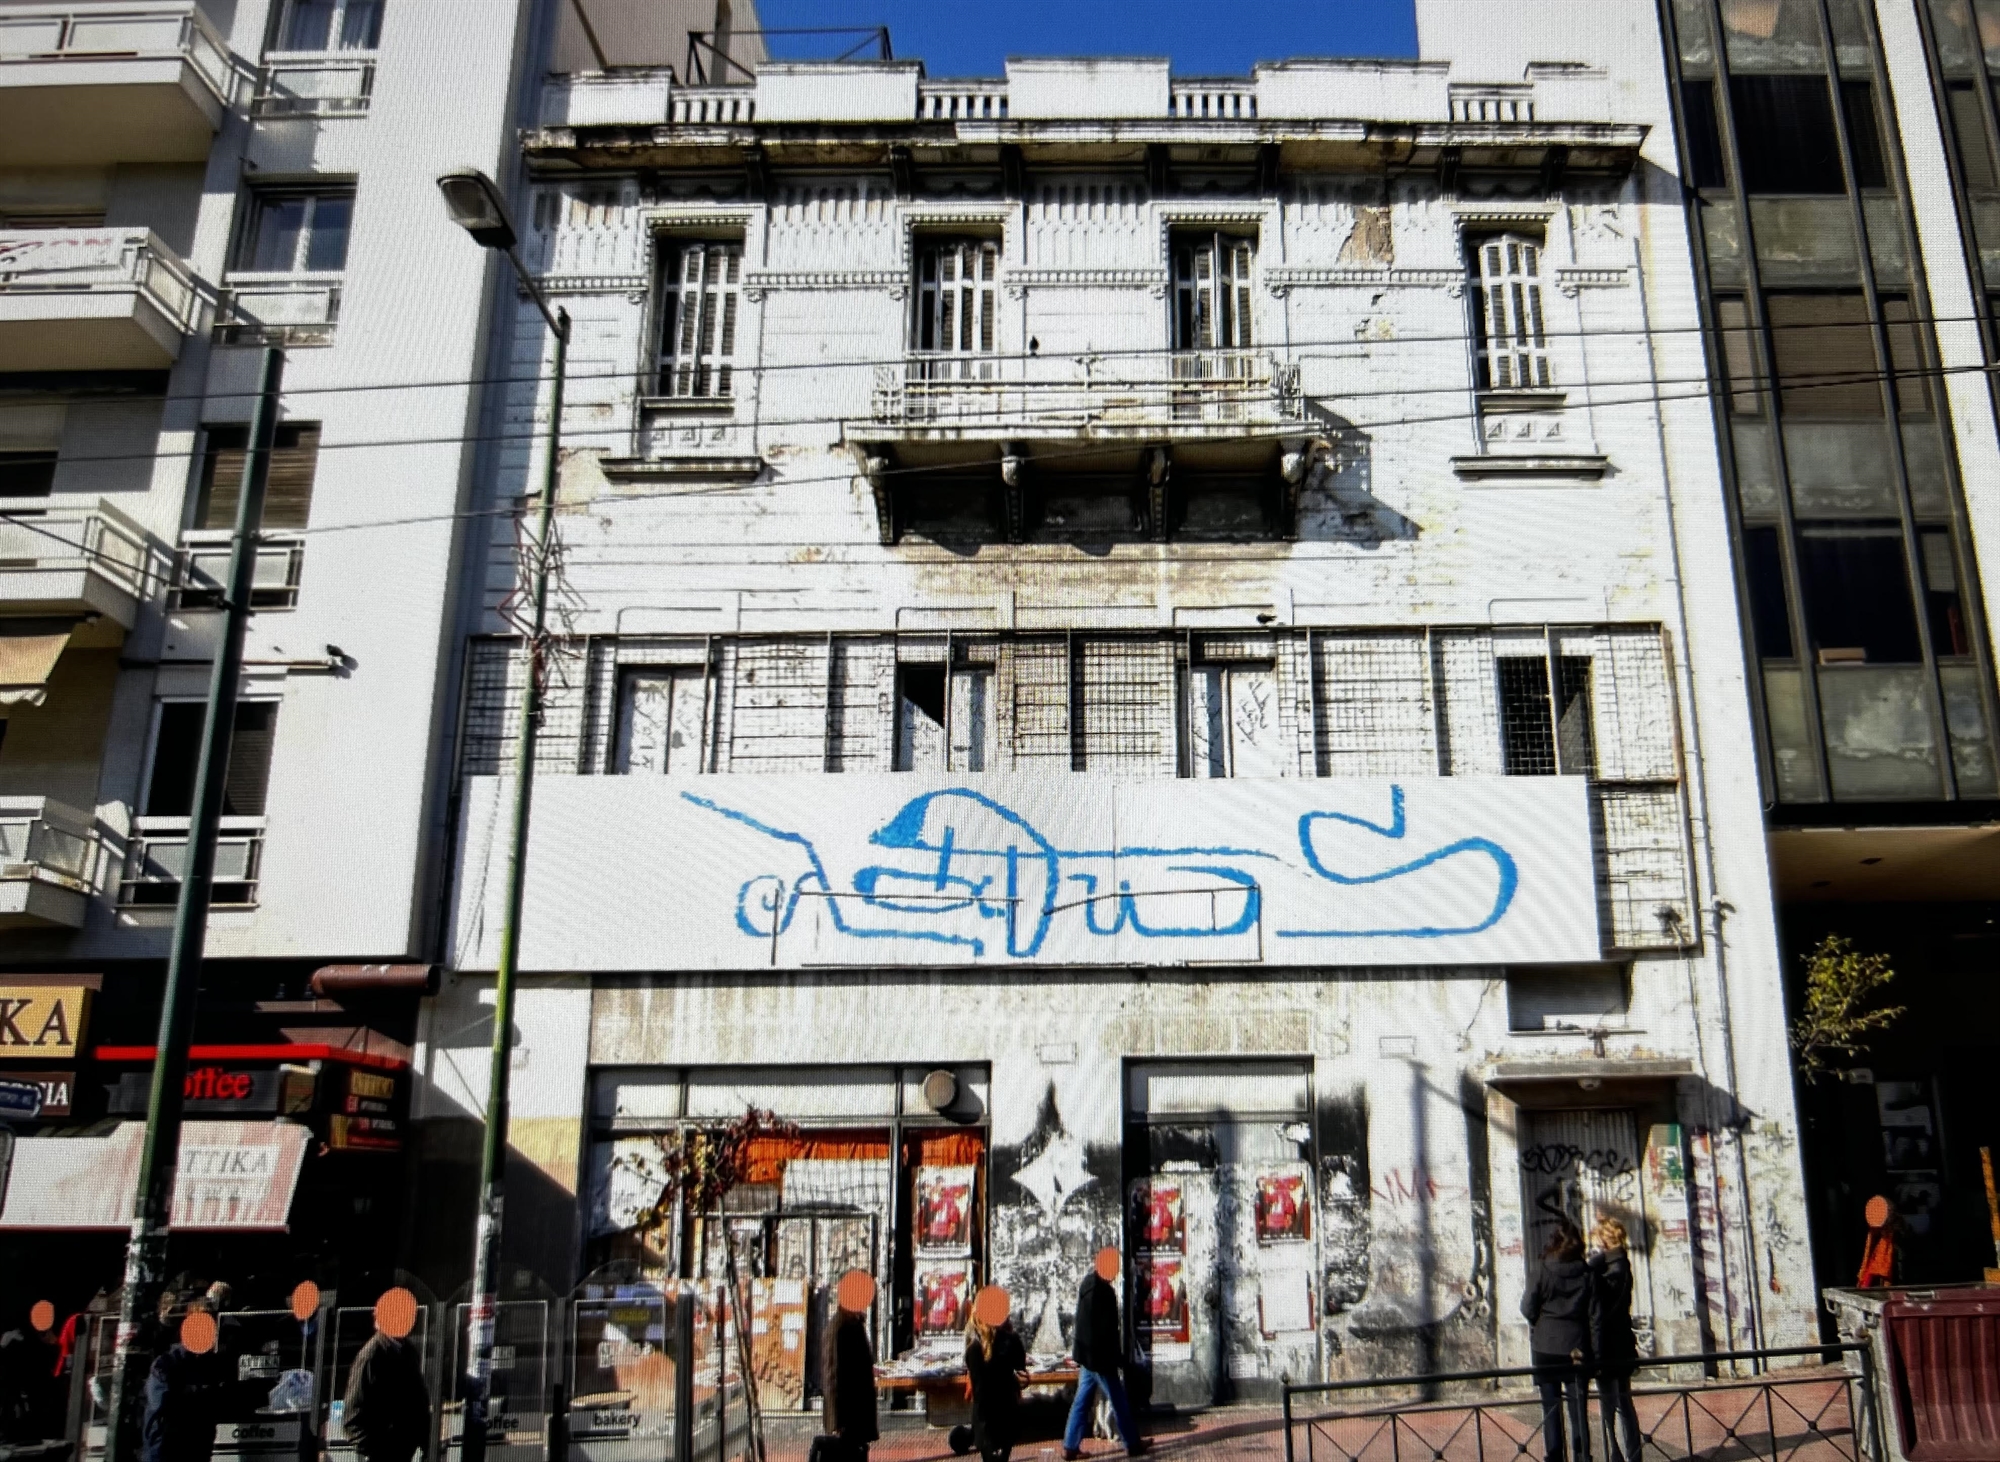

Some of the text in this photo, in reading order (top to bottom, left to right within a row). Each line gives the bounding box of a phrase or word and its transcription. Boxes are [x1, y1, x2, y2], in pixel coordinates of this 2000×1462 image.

[185, 1150, 267, 1173] TTIKA
[485, 1414, 519, 1429] offee
[594, 1411, 642, 1427] bakery
[232, 1424, 275, 1439] coffee
